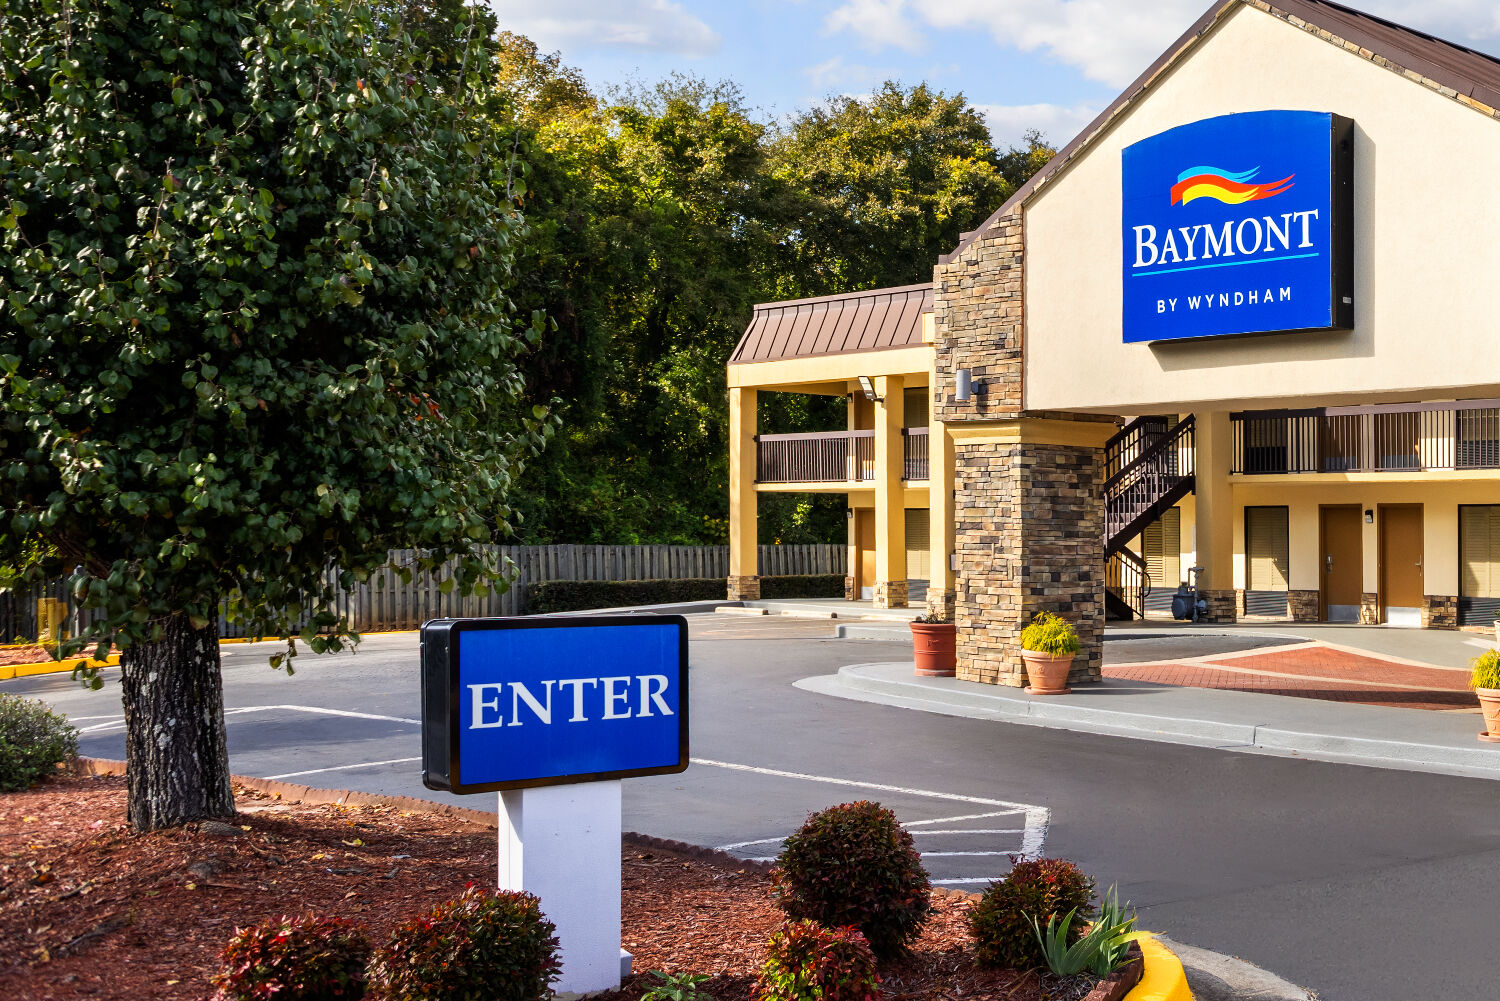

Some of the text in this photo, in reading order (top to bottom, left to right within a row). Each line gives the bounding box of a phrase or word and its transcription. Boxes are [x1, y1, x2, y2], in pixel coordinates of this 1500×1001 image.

[1132, 209, 1319, 268] BAYMONT
[1157, 286, 1292, 314] BY WYNDHAM
[466, 674, 675, 730] ENTER
